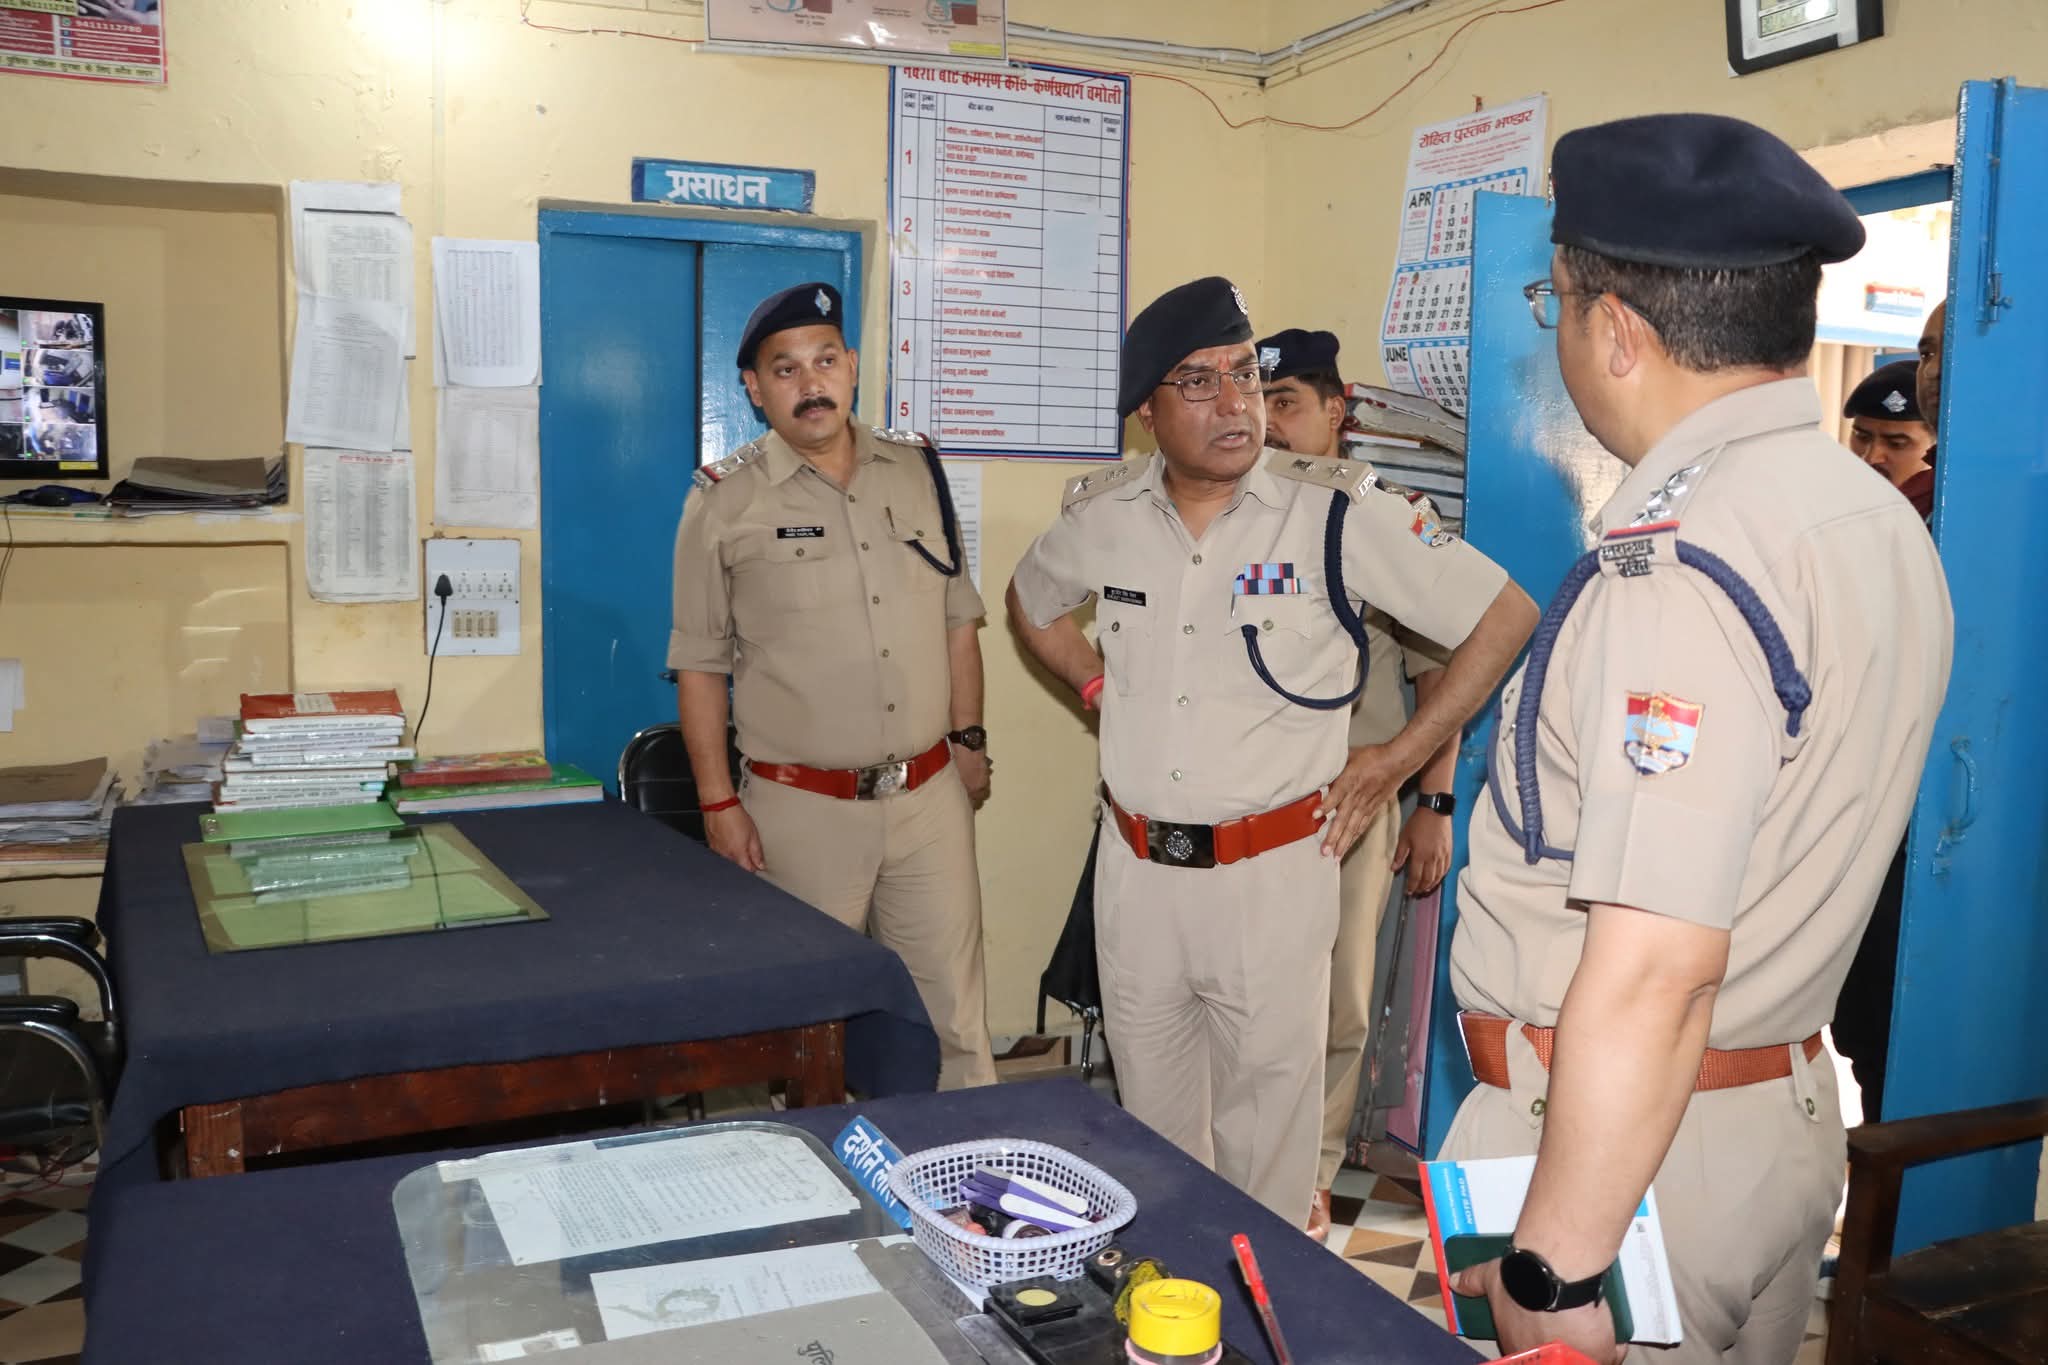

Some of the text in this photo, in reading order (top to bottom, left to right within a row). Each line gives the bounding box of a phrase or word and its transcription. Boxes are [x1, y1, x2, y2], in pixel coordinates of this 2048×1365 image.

[1419, 109, 1534, 148] रोहित पुस्तक भण्डार
[905, 149, 913, 165] 1
[665, 170, 772, 205] प्रसाधन
[1409, 191, 1432, 208] APR
[903, 217, 912, 233] 2
[1448, 217, 1455, 227] 13
[1445, 230, 1454, 241] 20
[1458, 229, 1467, 239] 21
[1443, 243, 1452, 254] 27
[902, 280, 911, 295] 3
[1434, 284, 1440, 294] 6
[1448, 283, 1453, 292] 7
[1427, 310, 1437, 319] 20
[1441, 309, 1449, 318] 21
[1454, 308, 1463, 318] 22
[1399, 323, 1408, 333] 25
[1411, 323, 1421, 332] 26
[1424, 322, 1434, 332] 27
[1450, 320, 1460, 330] 29
[901, 339, 910, 354] 4
[1386, 347, 1408, 362] JUNE
[1427, 351, 1432, 360] 1
[1432, 375, 1441, 385] 15
[1458, 375, 1466, 384] 17
[1436, 387, 1447, 396] 22
[1449, 387, 1460, 396] 23
[900, 402, 909, 417] 5
[1358, 472, 1376, 496] IPS
[843, 1125, 886, 1178] दर्शन
